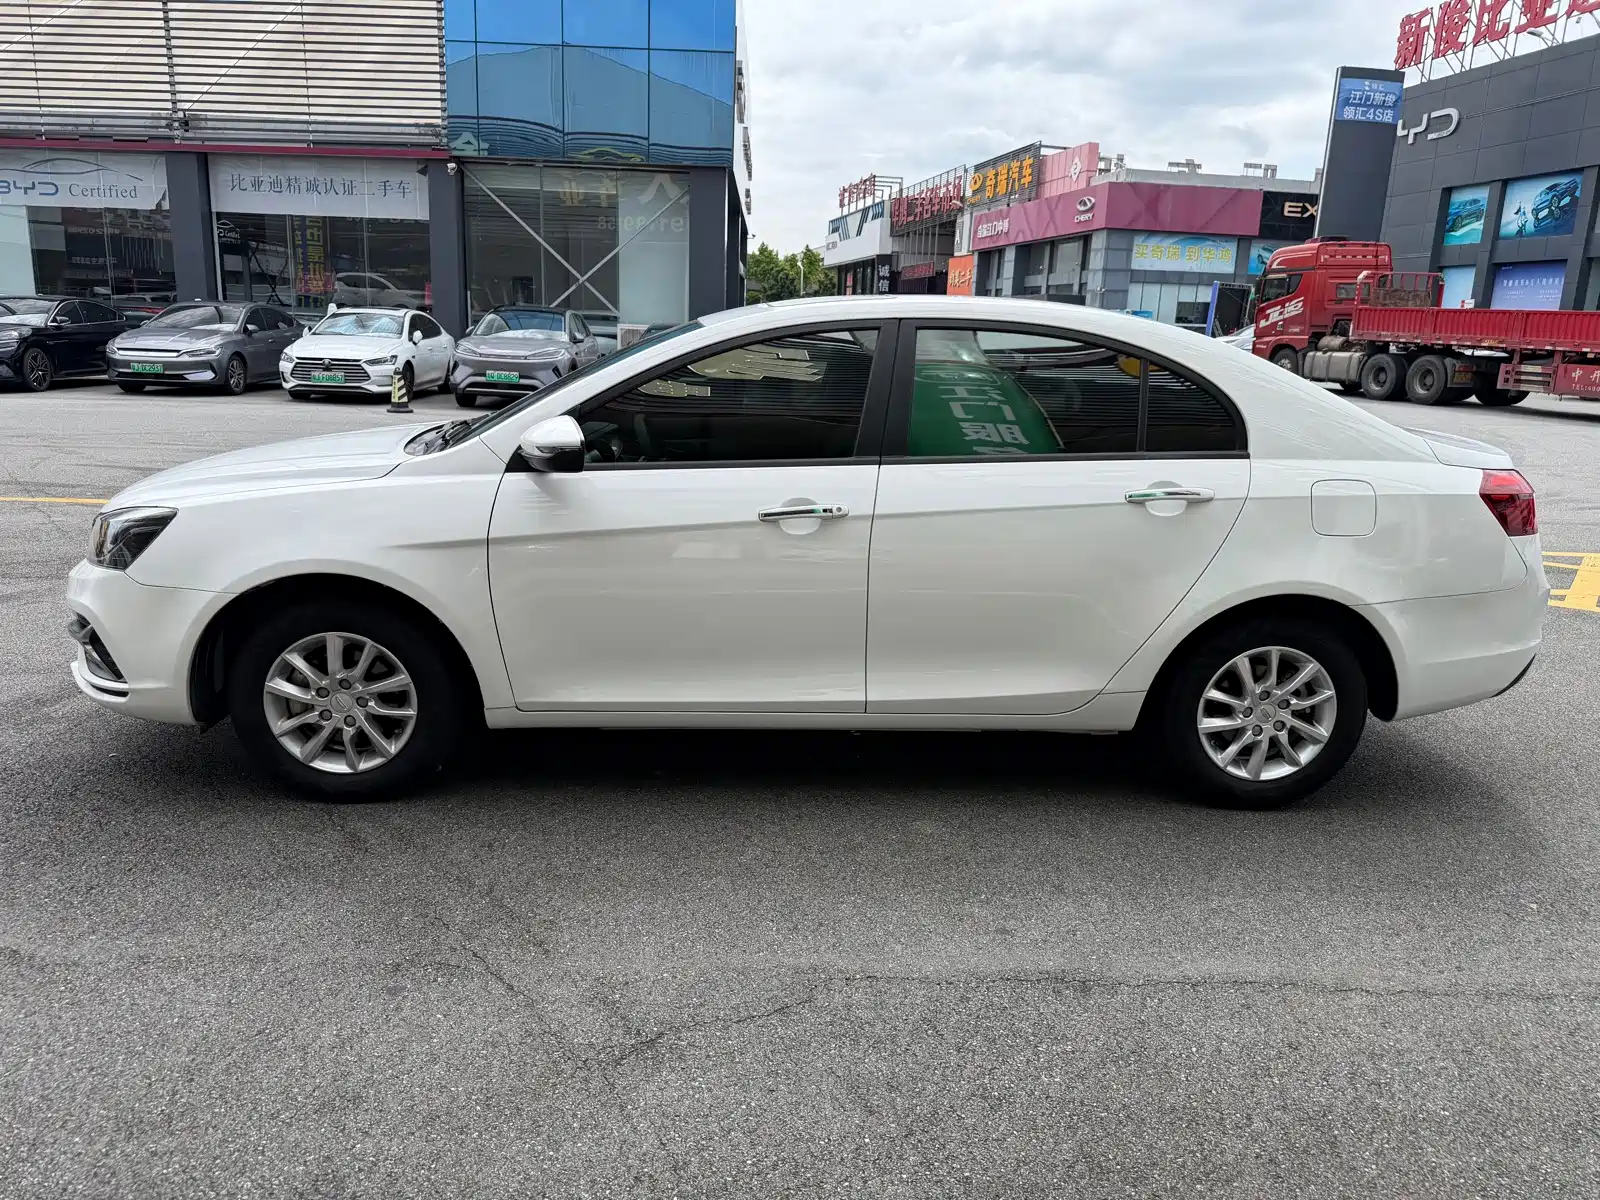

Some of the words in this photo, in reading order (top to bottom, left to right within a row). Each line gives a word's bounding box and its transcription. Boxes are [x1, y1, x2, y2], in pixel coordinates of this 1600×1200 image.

[1394, 0, 1600, 70] 新俊比亚
[1349, 91, 1396, 106] 江门新俊
[1343, 106, 1394, 123] 领汇4S店
[230, 172, 413, 199] 比亚迪精诚认证二手车
[985, 154, 1034, 199] 奇瑞汽车
[0, 180, 59, 196] BYD
[69, 183, 138, 198] Certified
[1074, 212, 1095, 223] CHERY
[1134, 243, 1181, 261] 买奇瑞
[1185, 245, 1232, 263] 到华鸿
[878, 264, 890, 292] 诚信
